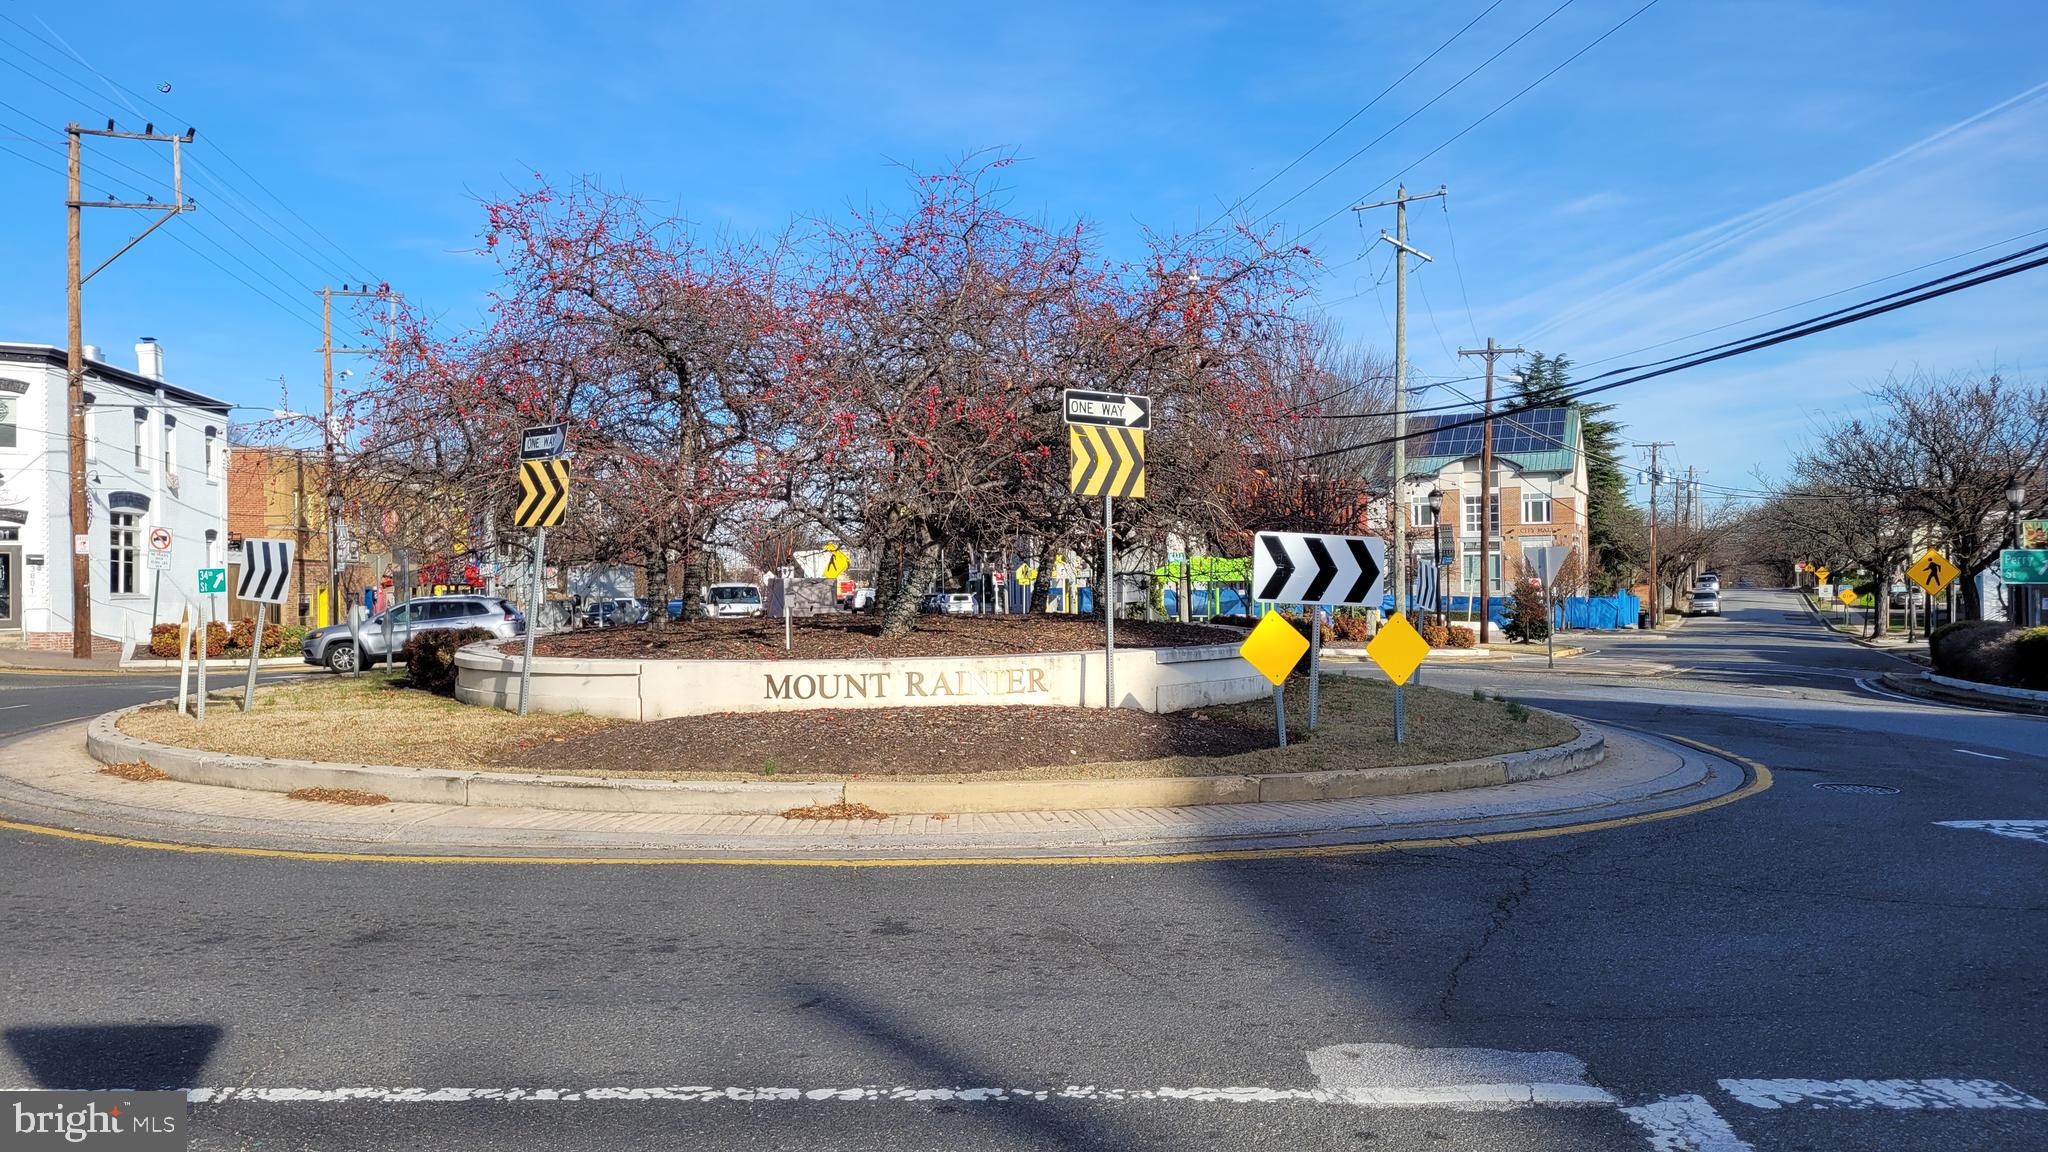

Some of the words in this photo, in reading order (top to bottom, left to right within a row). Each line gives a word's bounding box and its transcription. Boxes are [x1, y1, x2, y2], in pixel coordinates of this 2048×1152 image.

[1071, 400, 1094, 414] ONE
[1101, 403, 1125, 417] WAY
[527, 437, 540, 449] ONE
[543, 435, 556, 448] WAY
[2005, 555, 2033, 566] Perry
[2005, 569, 2017, 579] St
[200, 582, 208, 592] St
[763, 671, 891, 700] MOUNT
[905, 668, 1048, 697] RAINIER
